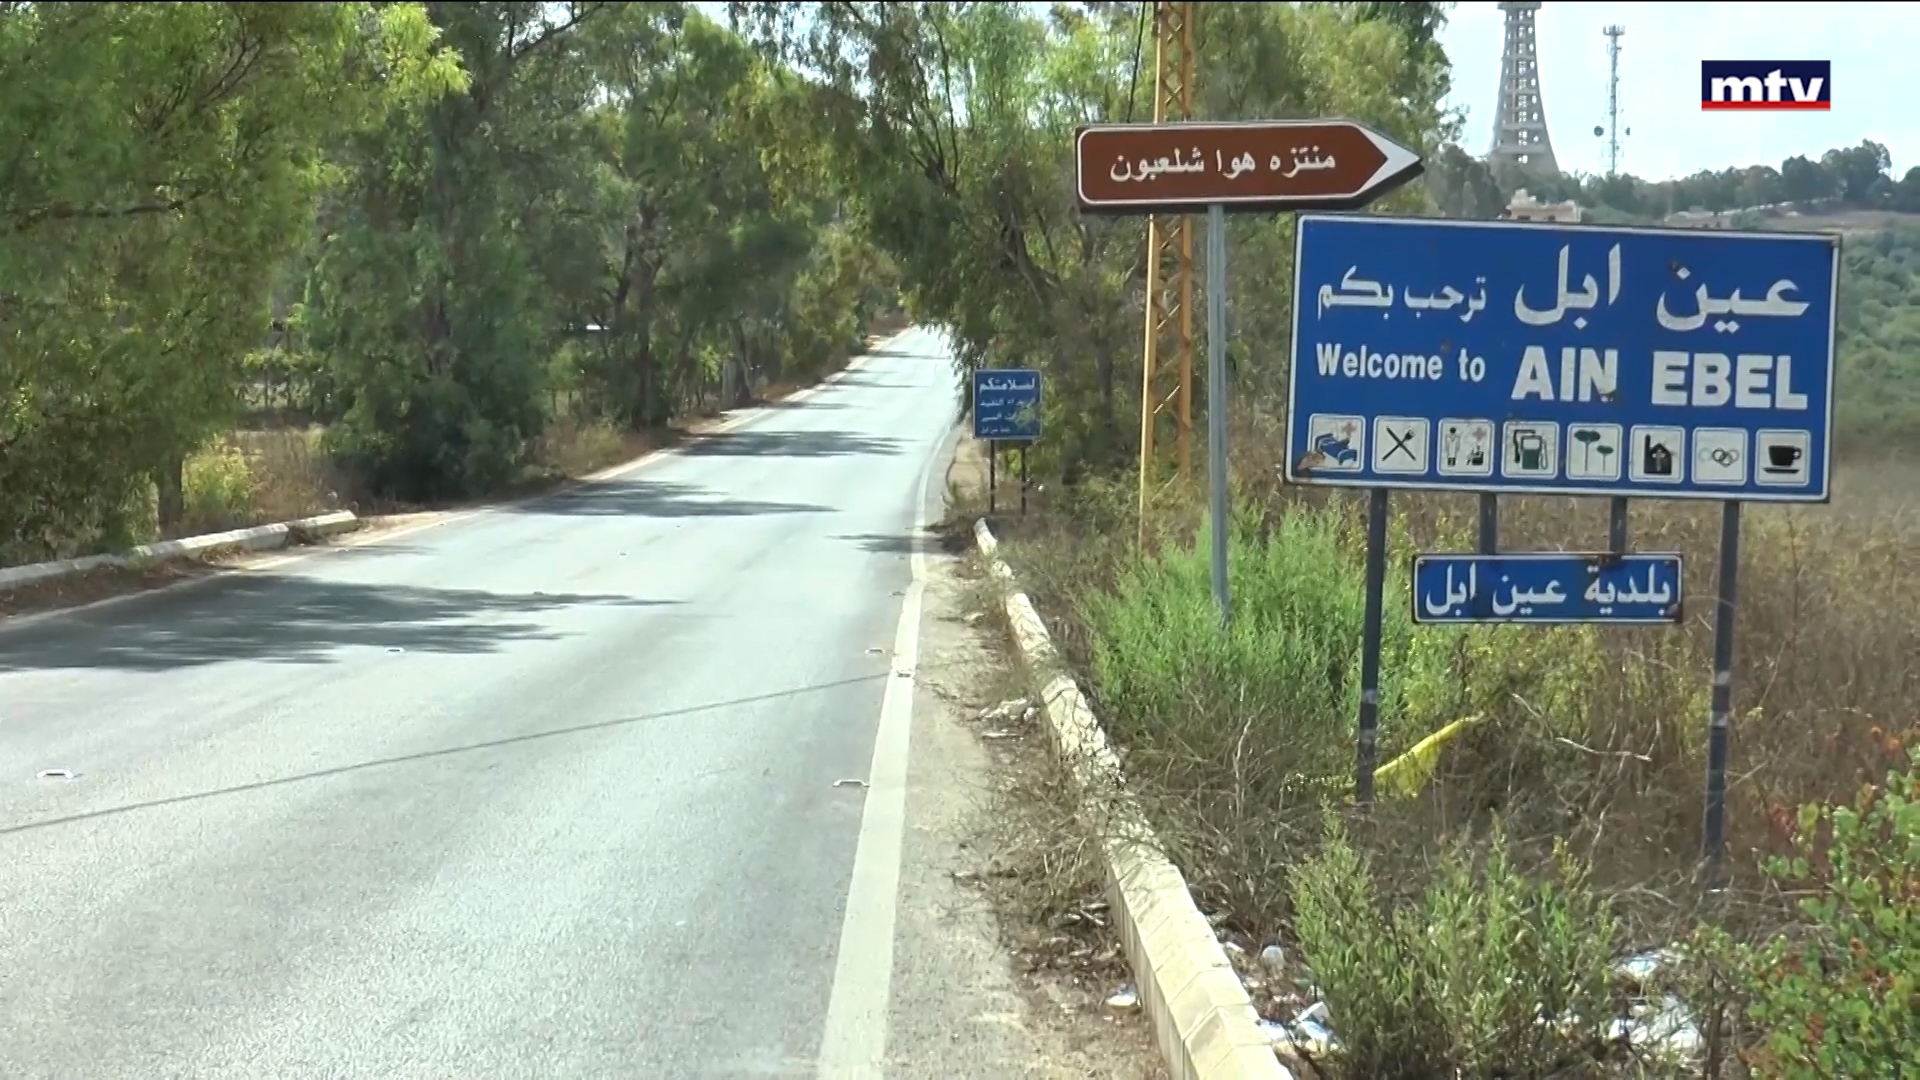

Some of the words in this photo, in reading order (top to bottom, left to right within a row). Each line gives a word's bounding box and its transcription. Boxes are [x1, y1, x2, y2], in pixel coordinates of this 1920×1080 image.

[1110, 145, 1205, 182] شلعبون
[1216, 149, 1256, 180] هوا
[1269, 145, 1336, 178] منتزه
[1318, 265, 1394, 321] بكم
[1404, 275, 1487, 323] ترحب
[1514, 243, 1621, 330] ابل
[1656, 266, 1811, 334] عين
[1316, 342, 1443, 380] Welcome
[1458, 347, 1486, 382] to
[1511, 345, 1619, 402] AIN
[1651, 350, 1809, 410] EBEL
[1425, 562, 1477, 617] ابل
[1492, 574, 1567, 616] عين
[1584, 563, 1671, 616] بلدية
